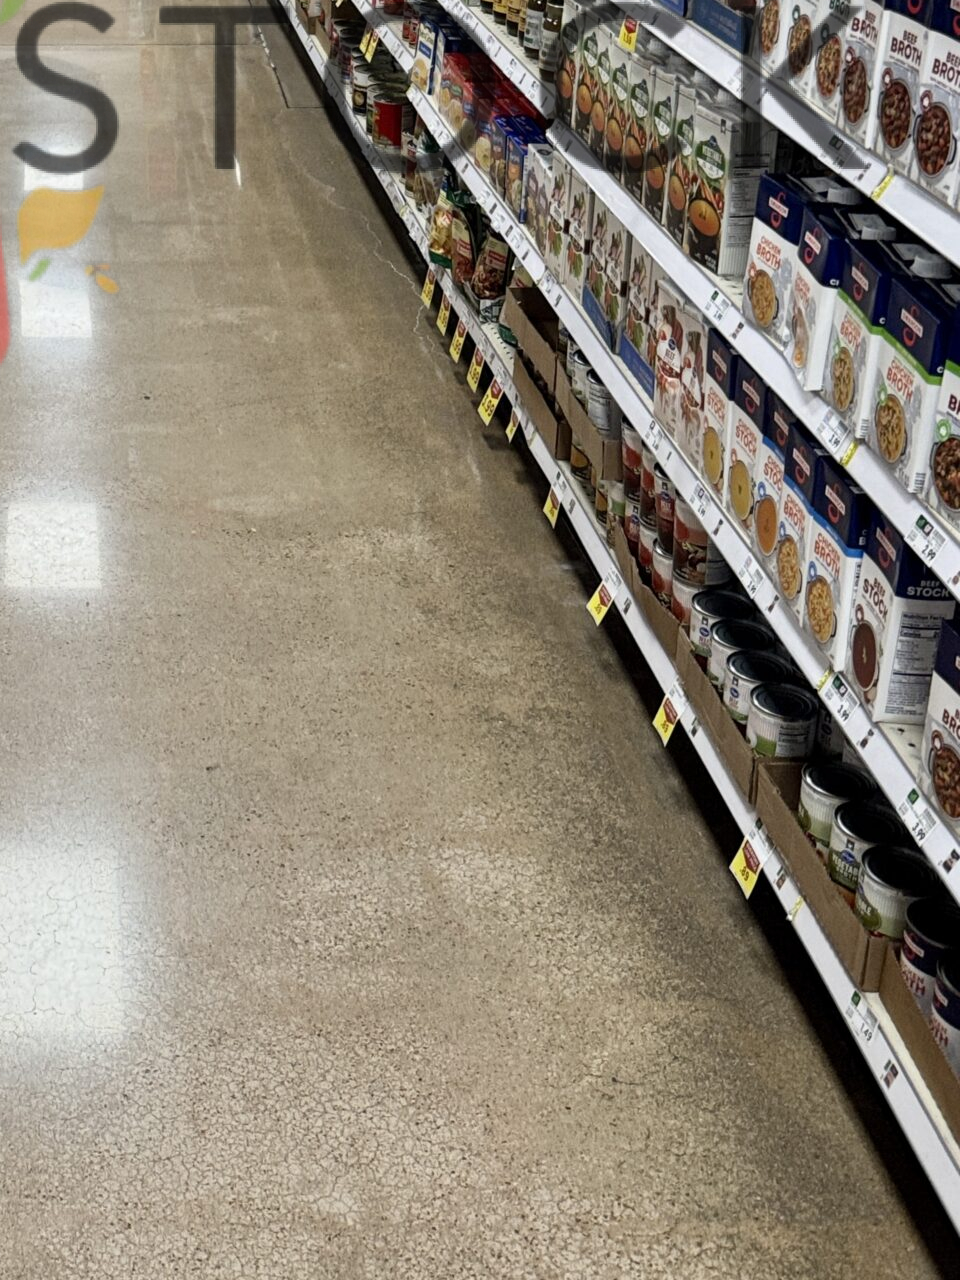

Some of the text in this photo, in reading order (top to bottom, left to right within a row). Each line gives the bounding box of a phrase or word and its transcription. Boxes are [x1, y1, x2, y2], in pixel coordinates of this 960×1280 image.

[851, 17, 879, 42] BROTH
[903, 30, 918, 46] BEEF
[891, 37, 922, 67] BROTH
[756, 243, 781, 269] BROTH
[886, 367, 913, 401] BROTH
[814, 541, 840, 577] BROTH
[863, 578, 888, 622] STOCK
[907, 586, 950, 598] STOCK
